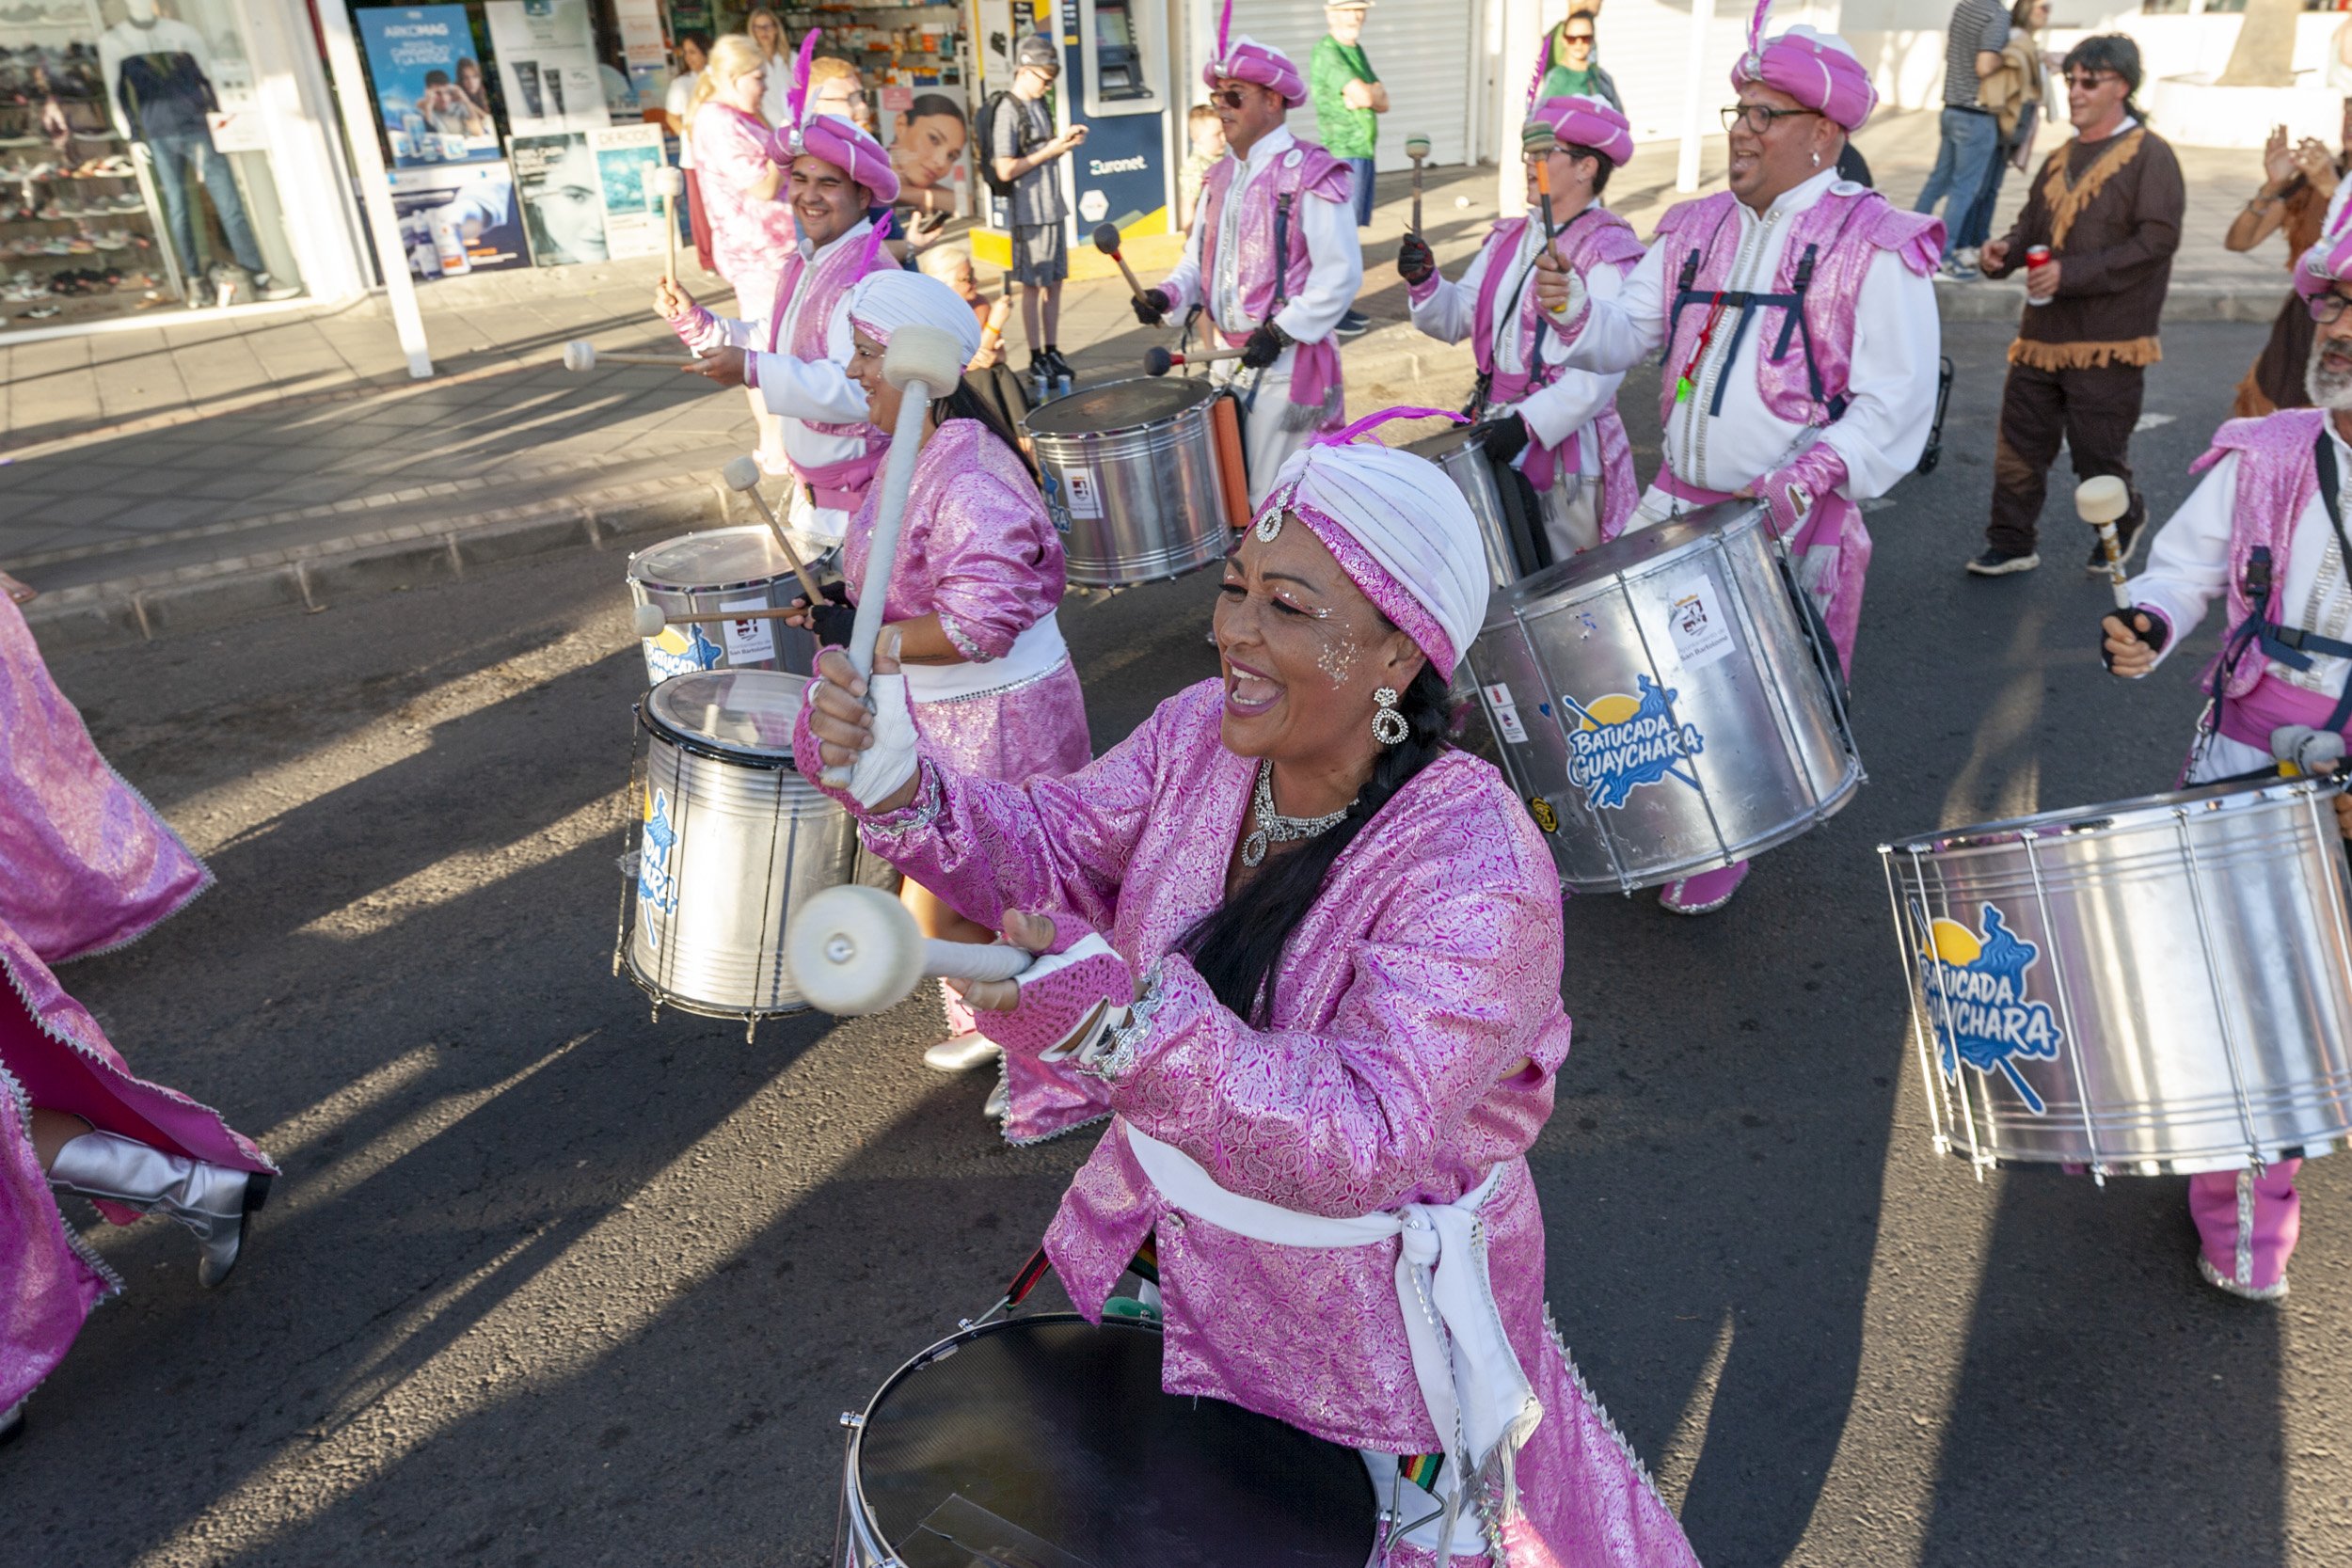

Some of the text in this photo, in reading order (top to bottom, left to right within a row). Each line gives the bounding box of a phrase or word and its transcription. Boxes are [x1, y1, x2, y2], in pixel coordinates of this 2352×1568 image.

[384, 23, 450, 39] ARKOMAG
[1572, 726, 1701, 784] GUAYCHARA
[1573, 714, 1671, 755] BATUCADA
